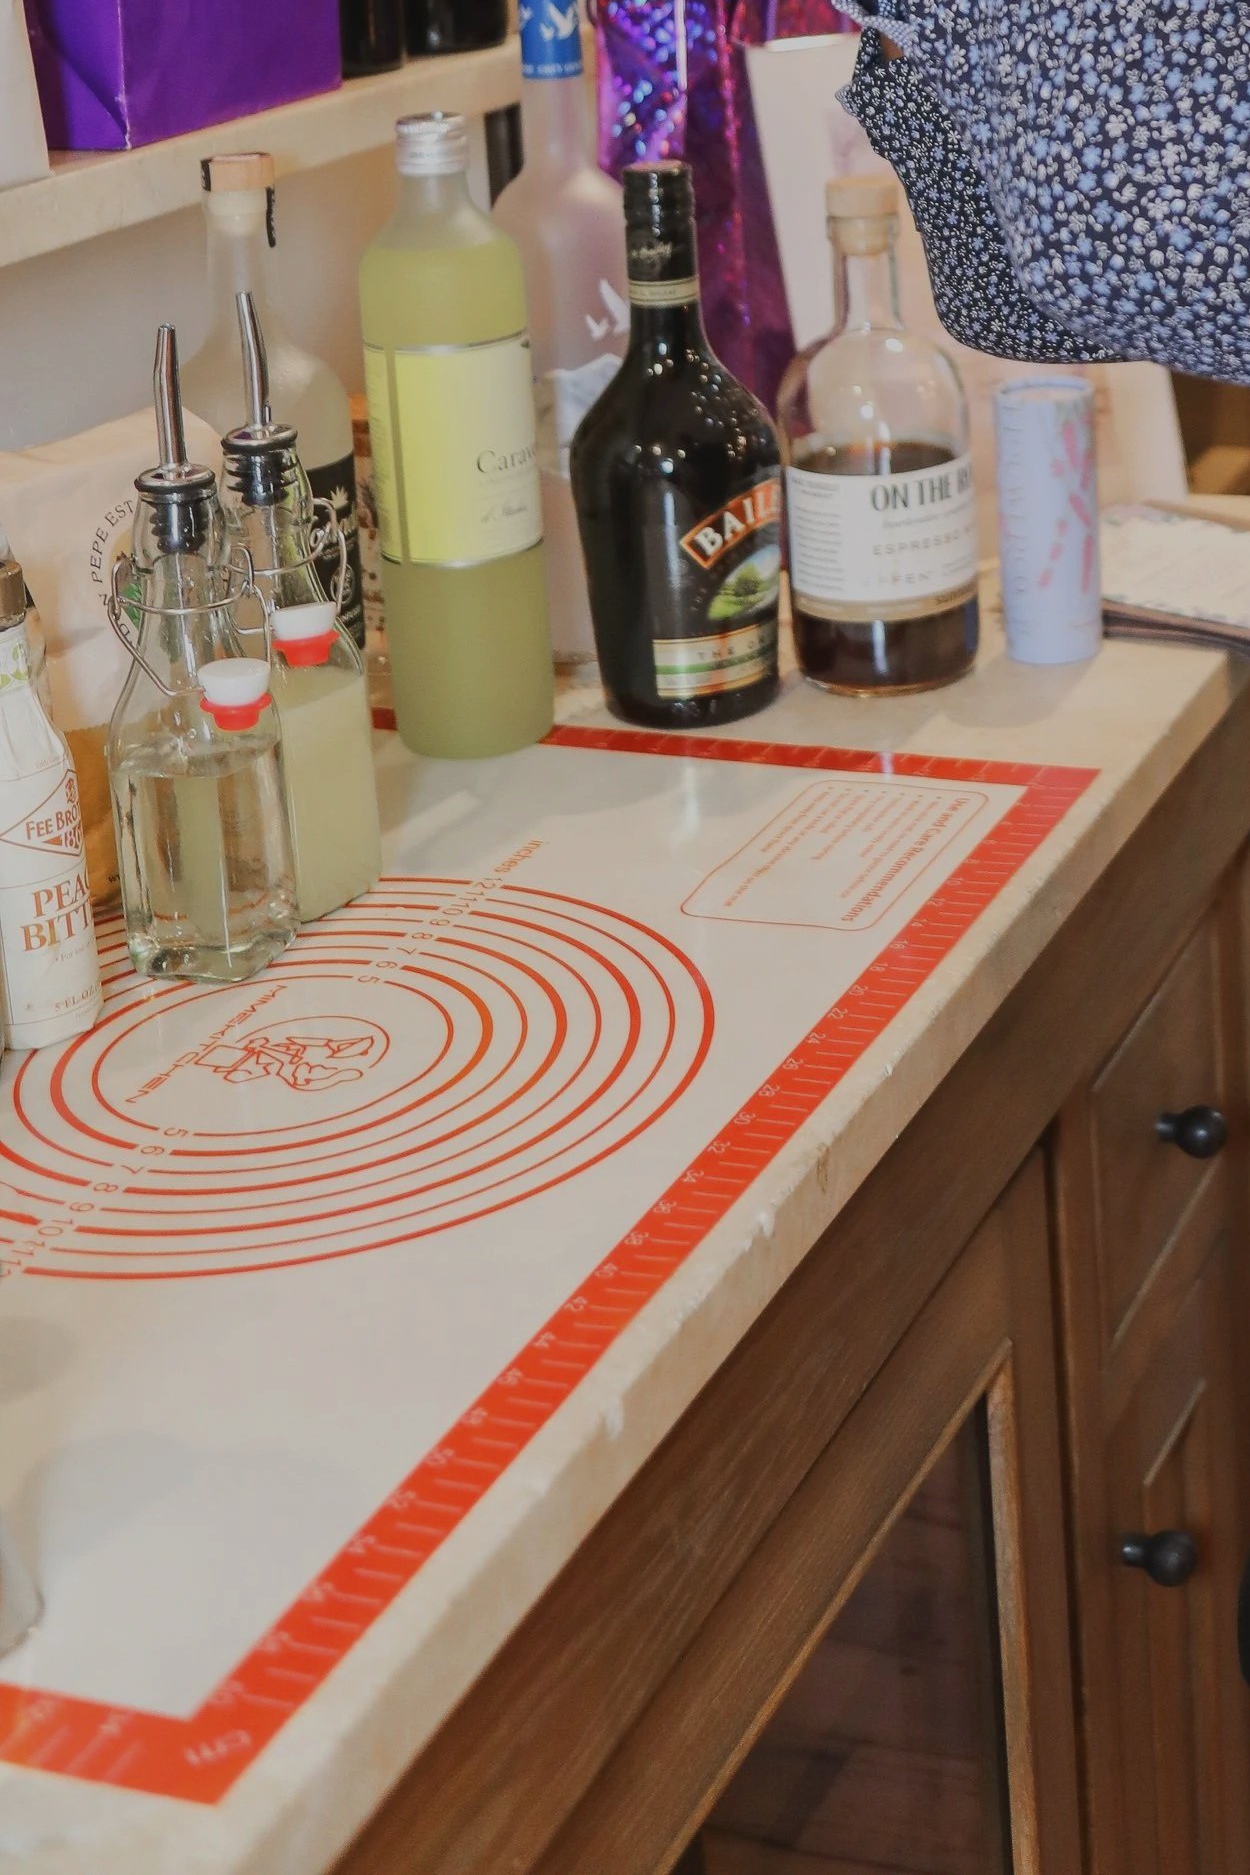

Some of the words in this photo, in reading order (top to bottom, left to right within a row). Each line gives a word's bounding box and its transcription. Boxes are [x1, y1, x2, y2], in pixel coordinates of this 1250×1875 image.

[870, 481, 909, 512] ON
[916, 475, 952, 507] THE
[90, 528, 109, 584] PEPE
[25, 818, 54, 841] FEE
[55, 803, 81, 832] BRO
[493, 838, 544, 874] inches
[20, 900, 91, 953] BITT
